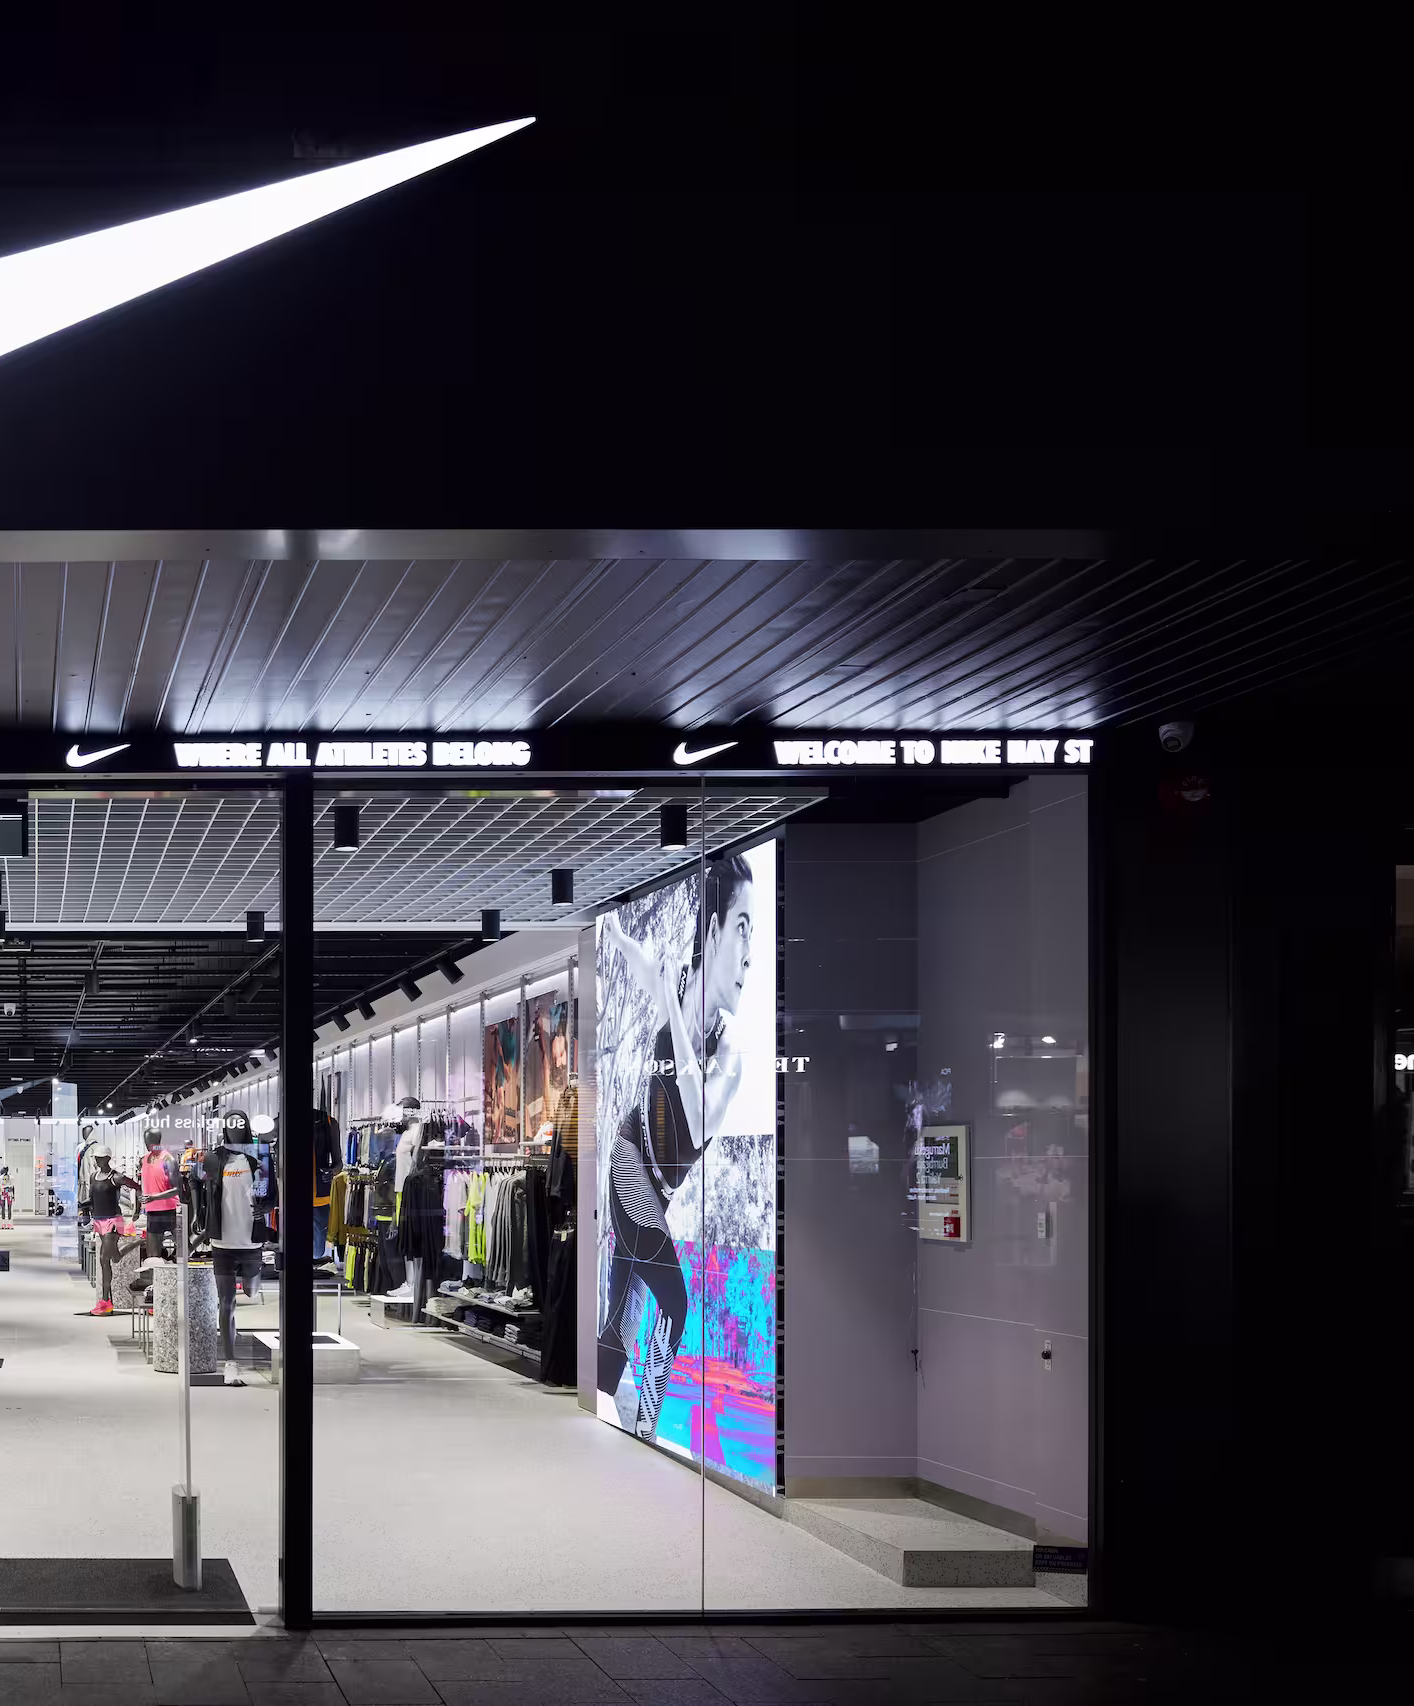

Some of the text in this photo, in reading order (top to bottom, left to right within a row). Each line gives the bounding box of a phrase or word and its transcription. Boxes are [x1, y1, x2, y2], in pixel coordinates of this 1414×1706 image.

[173, 741, 532, 767] WHERE ALL ATHLETES BELONG
[773, 740, 1094, 765] WELCOME TO NIKE HAY ST
